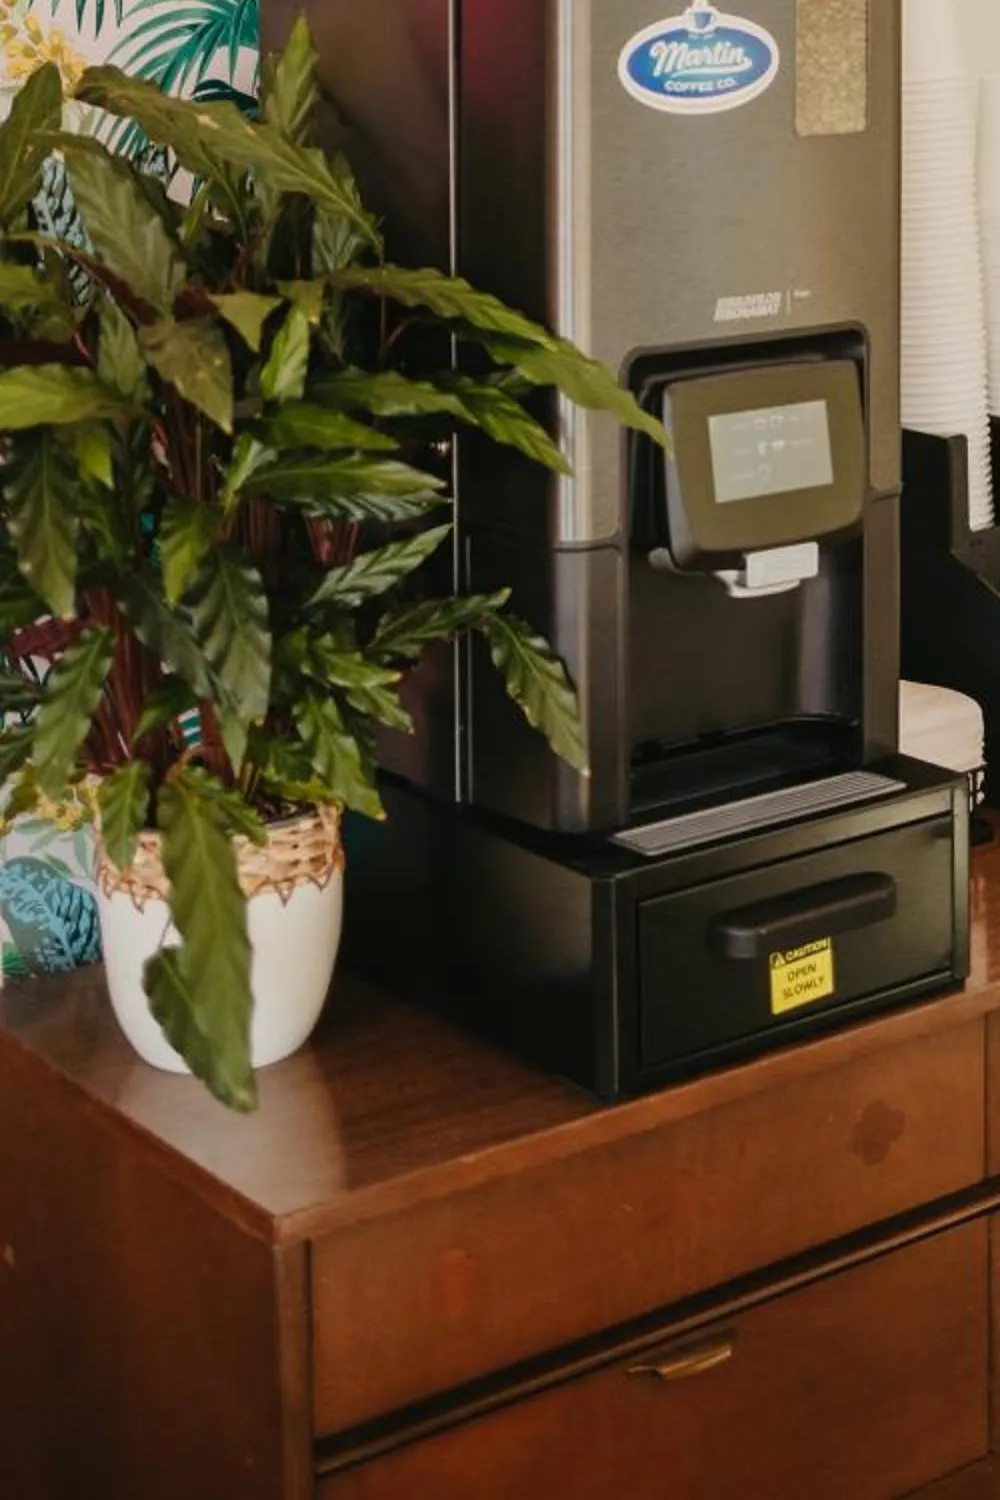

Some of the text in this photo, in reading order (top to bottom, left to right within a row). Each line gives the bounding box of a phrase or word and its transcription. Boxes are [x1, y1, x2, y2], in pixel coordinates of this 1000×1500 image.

[648, 40, 752, 78] Martin
[664, 80, 714, 92] COFFEE
[787, 962, 817, 981] OPEN
[783, 975, 824, 1000] SLOWLY
